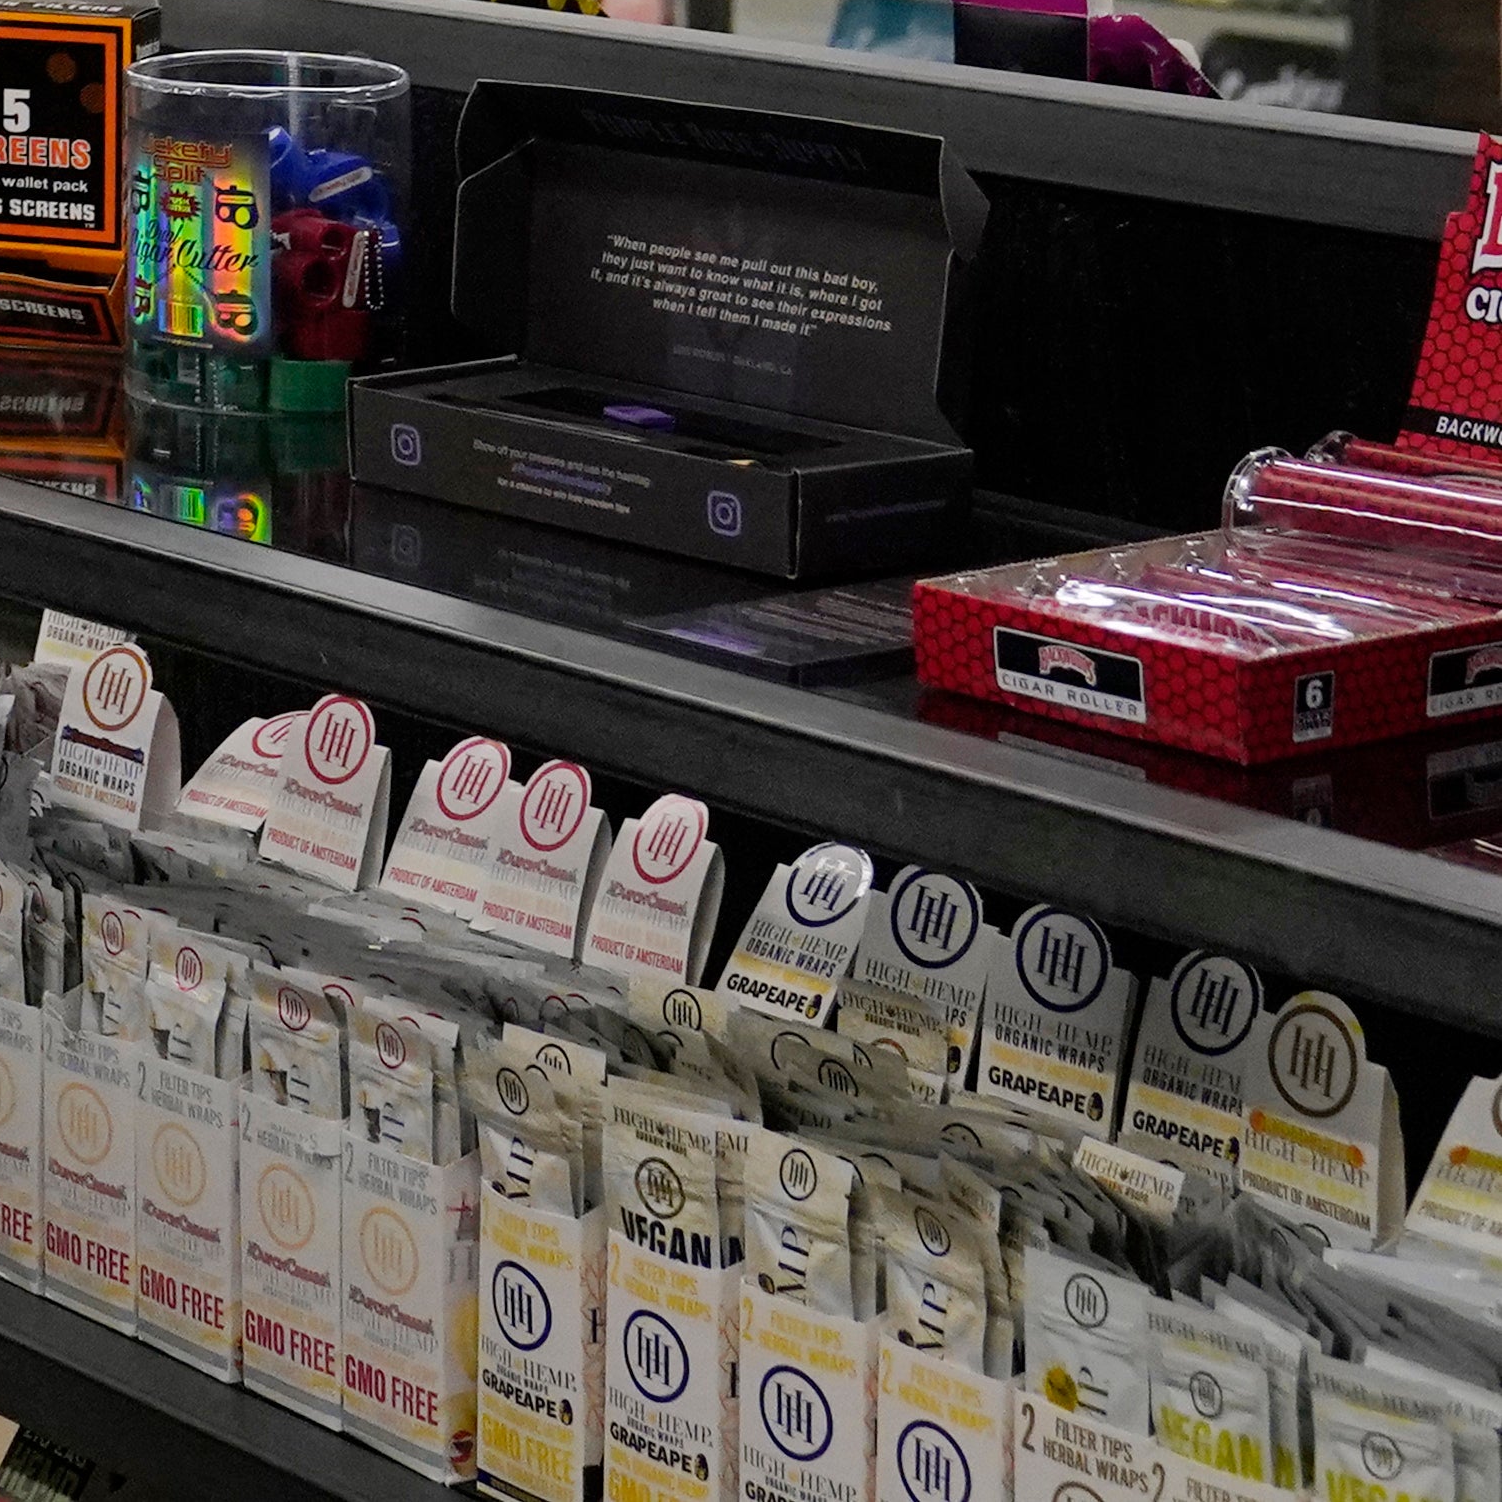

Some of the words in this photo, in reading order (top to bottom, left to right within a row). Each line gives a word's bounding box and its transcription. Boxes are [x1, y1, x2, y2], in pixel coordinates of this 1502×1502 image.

[2, 87, 31, 133] 5
[1, 176, 49, 190] wallet
[52, 180, 89, 194] pack
[9, 198, 96, 222] SCREENS
[176, 238, 261, 273] Cutter
[649, 243, 693, 260] people
[695, 251, 718, 265] see
[719, 255, 740, 268] me
[741, 258, 769, 273] pull
[770, 264, 793, 277] out
[794, 266, 820, 282] this
[823, 270, 849, 287] bad
[851, 275, 879, 294] boy,
[590, 267, 603, 282] it,
[605, 271, 630, 285] and
[631, 273, 652, 289] it's
[653, 280, 697, 298] always
[698, 287, 733, 302] great
[735, 293, 748, 306] to
[750, 297, 775, 310] see
[777, 300, 809, 317] their
[810, 308, 893, 332] expressions
[601, 251, 629, 268] they
[629, 256, 656, 271] just
[657, 262, 688, 277] want
[690, 266, 703, 280] to
[706, 269, 741, 286] know
[743, 277, 774, 292] what
[776, 281, 787, 294] it
[789, 284, 805, 298] is,
[809, 288, 848, 305] where
[851, 294, 857, 307] I
[859, 298, 883, 312] got
[652, 298, 686, 314] when
[688, 303, 694, 316] I
[696, 305, 718, 319] tell
[719, 309, 751, 326] them
[754, 314, 759, 327] I
[761, 317, 797, 334] made
[1001, 672, 1055, 697] CIGAR
[1066, 689, 1138, 717] ROLLER
[1305, 678, 1324, 709] 6
[58, 757, 99, 785] ORGANIC
[102, 774, 136, 797] WRAPS
[266, 826, 300, 849] PRODUCT
[300, 838, 310, 852] OF
[309, 839, 358, 871] AMSTERDAM
[388, 866, 422, 887] PRODUCT
[420, 876, 431, 889] OF
[431, 878, 479, 903] AMSTERDAM
[481, 900, 516, 925] PRODUCT
[515, 912, 526, 927] OF
[525, 913, 573, 940] AMSTERDAM
[751, 918, 794, 943] HIGH
[591, 934, 625, 958] PRODUCT
[624, 944, 637, 960] OF
[636, 946, 684, 975] AMSTERDAM
[745, 936, 794, 965] ORGANIC
[795, 949, 837, 979] WRAPS
[865, 958, 912, 988] HIGH
[725, 972, 807, 1015] GRAPEAPE
[994, 1001, 1043, 1034] HIGH
[994, 1023, 1053, 1058] ORGANIC
[1057, 1040, 1106, 1074] WRAPS
[137, 1060, 146, 1103] 2
[987, 1065, 1086, 1115] GRAPEAPE
[1142, 1066, 1198, 1101] ORGANIC
[613, 1105, 657, 1136] HIGH
[1131, 1109, 1225, 1159] GRAPEAPE
[1078, 1148, 1120, 1178] HIGH
[1244, 1127, 1295, 1163] HIGH
[1242, 1168, 1289, 1203] PRODUCT
[45, 1220, 83, 1267] GMO
[86, 1238, 131, 1286] FREE
[139, 1264, 177, 1310] GMO
[181, 1283, 226, 1331] FREE
[244, 1308, 285, 1357] GMO
[289, 1328, 336, 1377] FREE
[481, 1334, 513, 1369] HIGH
[345, 1352, 387, 1404] GMO
[391, 1374, 439, 1427] FREE
[481, 1368, 558, 1420] GRAPEAPE
[608, 1385, 645, 1420] HIGH
[609, 1420, 692, 1473] GRAPEAPE
[1021, 1402, 1036, 1454] 2
[1054, 1417, 1099, 1453] FILTER
[1100, 1433, 1133, 1464] TIPS
[744, 1444, 786, 1482] HIGH
[1042, 1435, 1093, 1476] HERBAL
[1095, 1460, 1149, 1495] WRAPS
